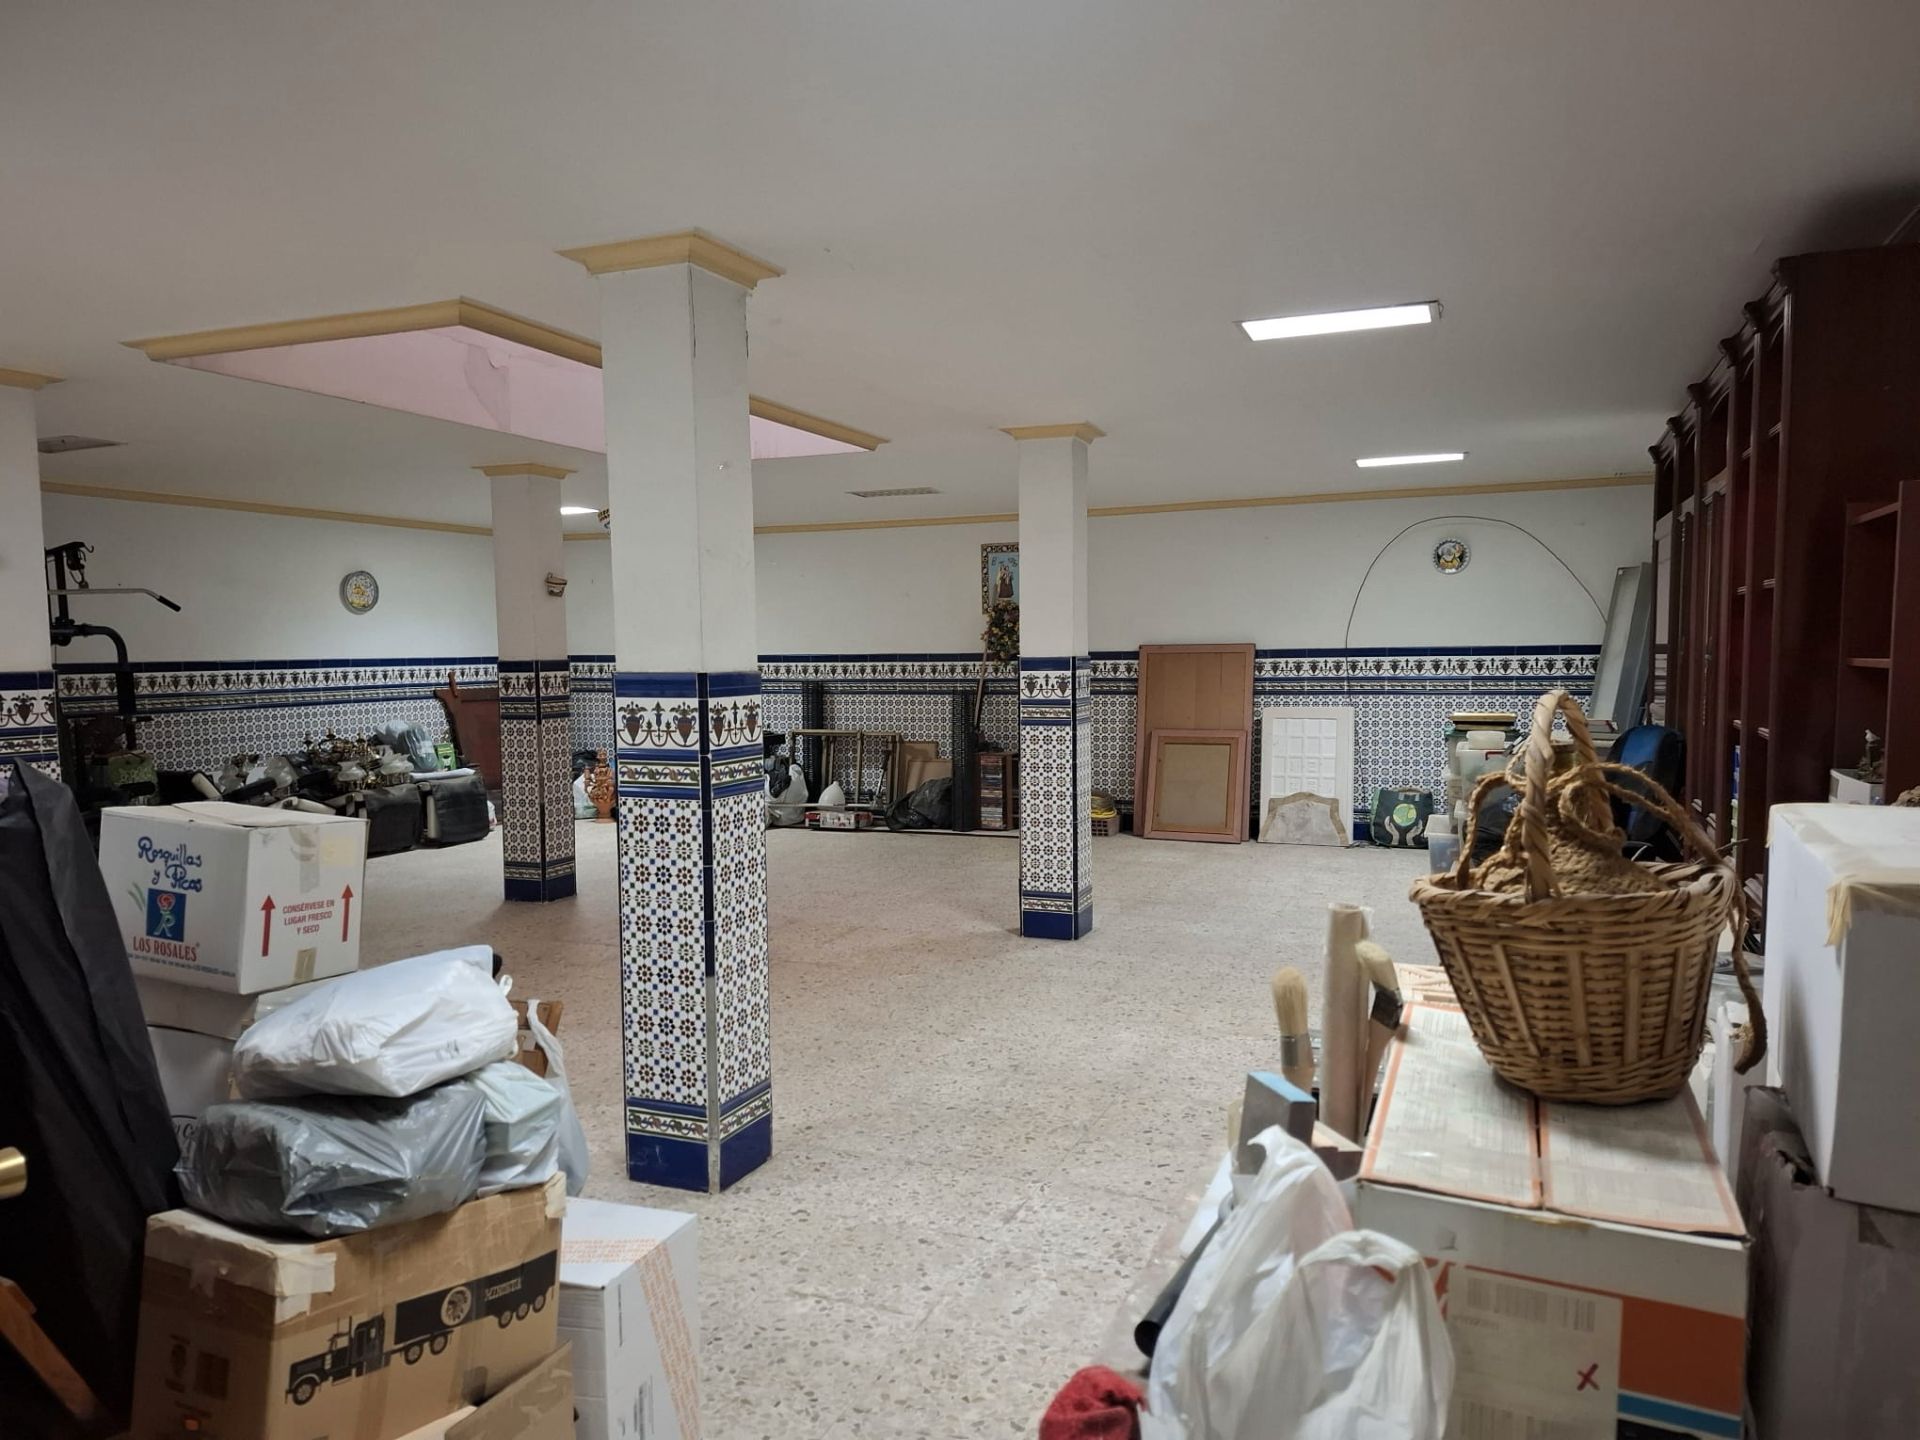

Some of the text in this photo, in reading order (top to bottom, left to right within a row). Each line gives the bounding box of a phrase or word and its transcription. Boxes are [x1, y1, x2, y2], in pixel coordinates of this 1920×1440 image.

[138, 836, 202, 868] Rosquillas
[152, 864, 203, 892] y Picos
[282, 900, 335, 914] CONSÉRVESE EN
[284, 911, 333, 926] LUGAR FRESCO
[297, 924, 320, 935] Y SECO
[133, 936, 197, 962] LOS ROSALES
